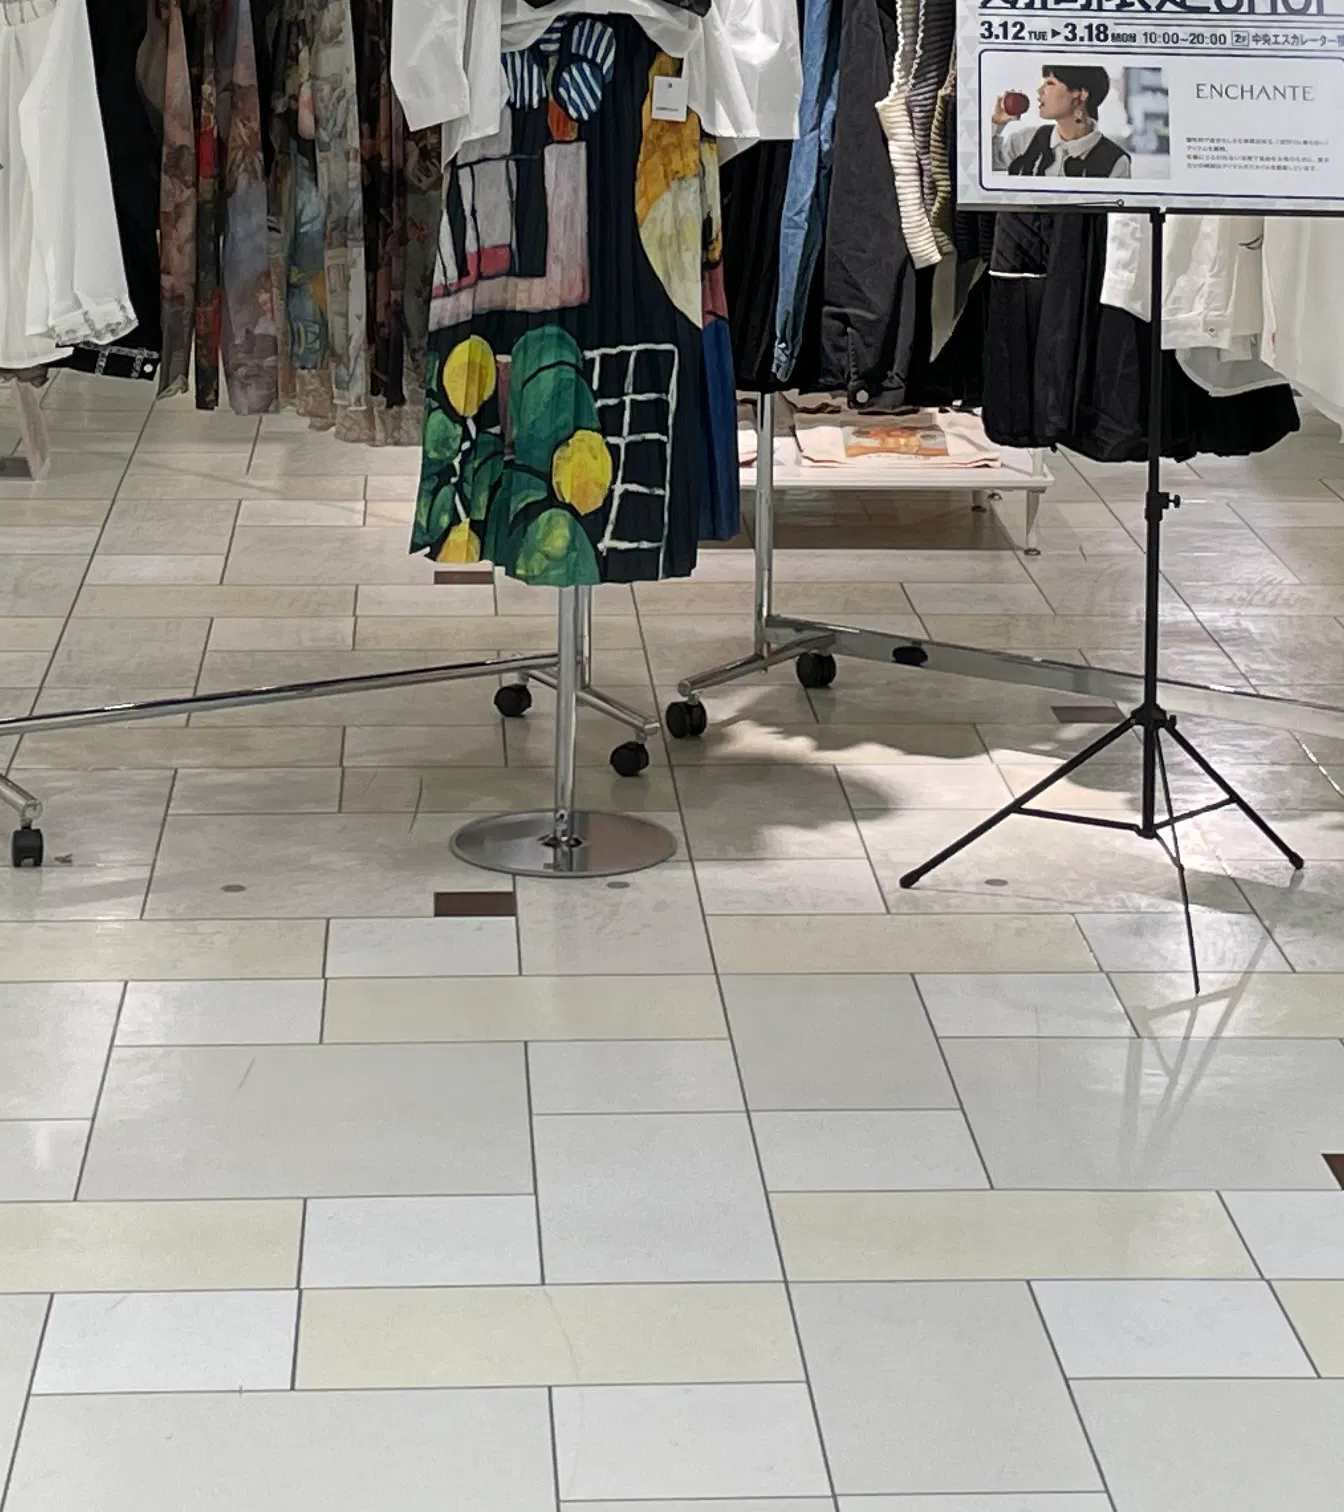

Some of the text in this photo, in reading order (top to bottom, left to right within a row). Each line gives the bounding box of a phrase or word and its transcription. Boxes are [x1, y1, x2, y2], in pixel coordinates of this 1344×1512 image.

[979, 19, 1026, 43] 3.12
[1027, 29, 1049, 42] TUE
[1062, 21, 1110, 44] 3.18
